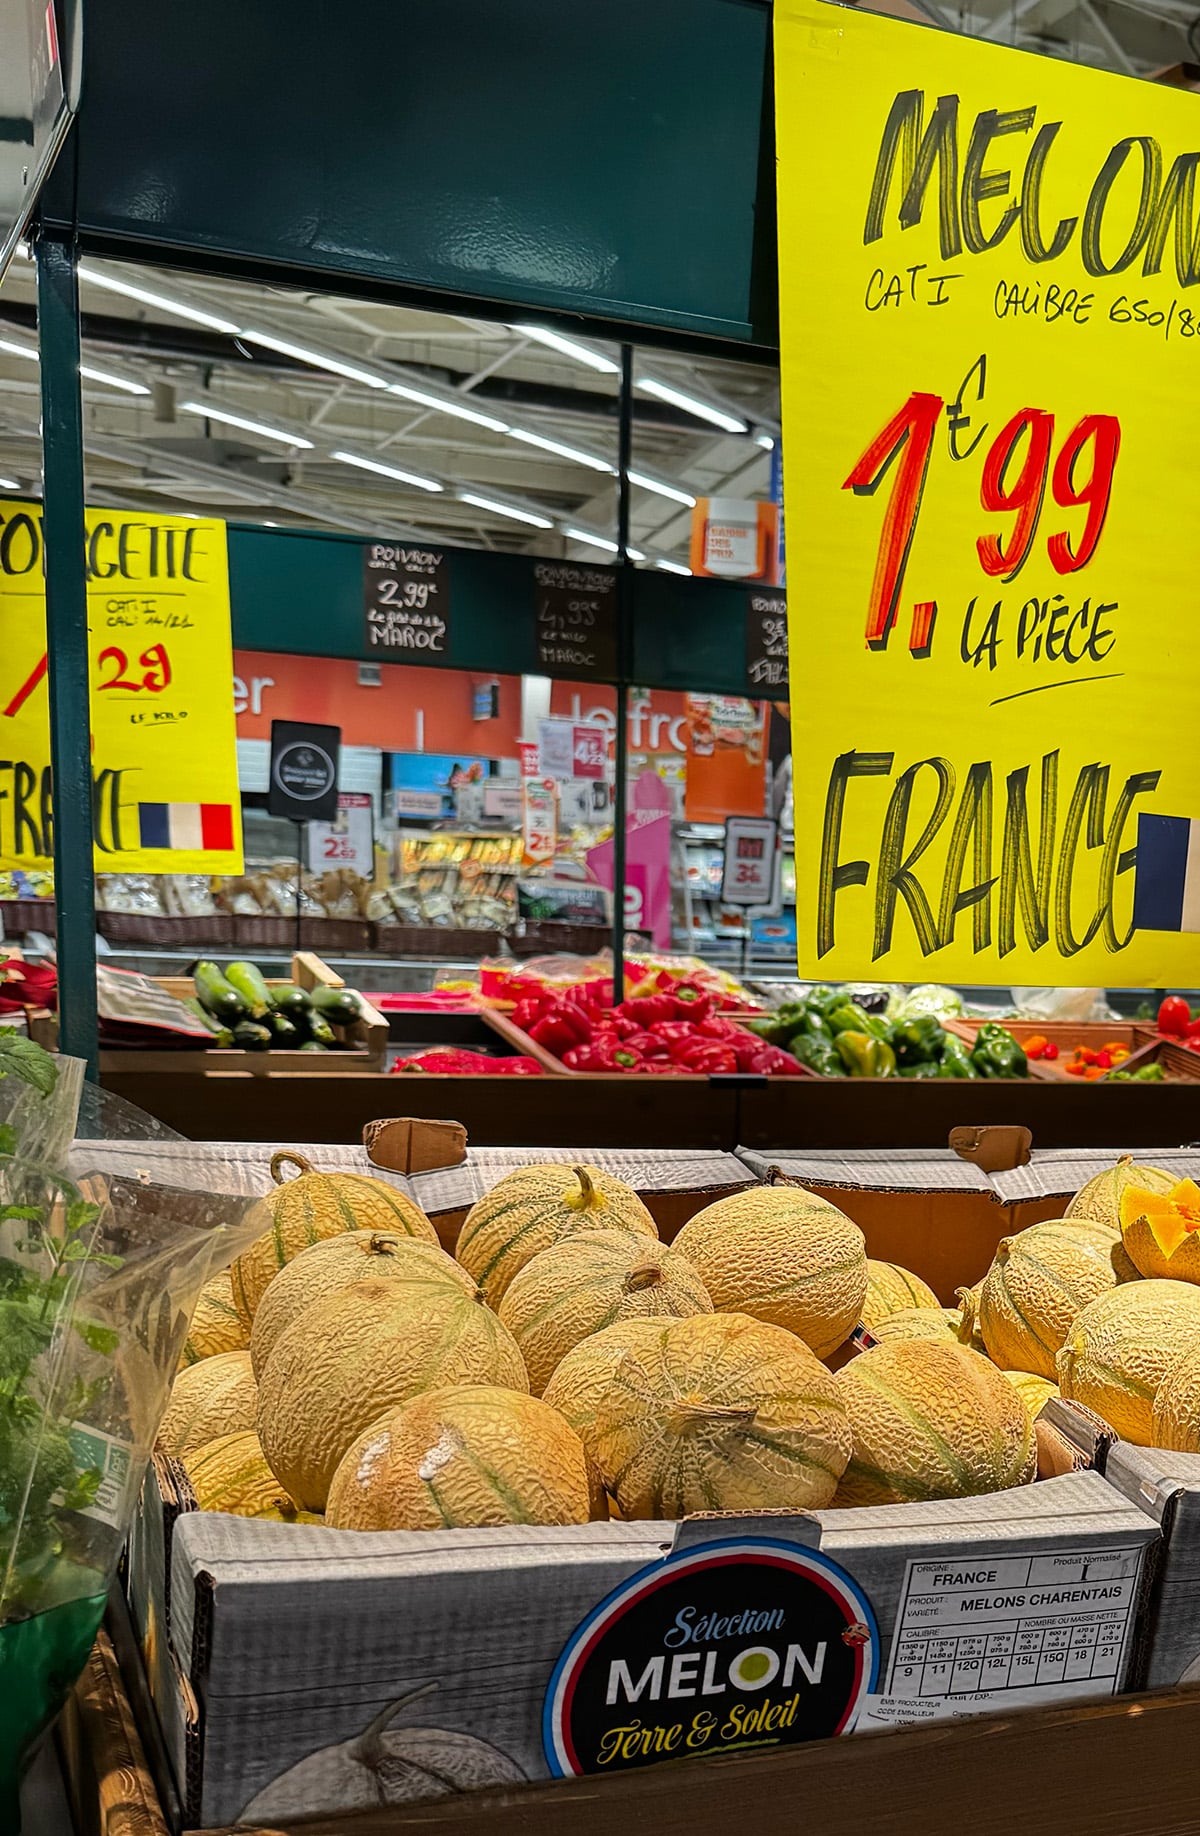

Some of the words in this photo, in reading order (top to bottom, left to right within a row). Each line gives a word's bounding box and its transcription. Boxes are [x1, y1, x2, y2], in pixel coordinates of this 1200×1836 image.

[864, 263, 928, 313] CAT
[928, 273, 965, 306] I
[370, 624, 444, 651] MAROC
[959, 596, 1002, 671] LA
[817, 748, 1162, 963] FRANCE
[932, 1570, 998, 1587] FRANCE
[960, 1595, 1026, 1612] MELONS
[1029, 1586, 1123, 1606] CHARENTAIS
[663, 1606, 786, 1649] Sélection
[604, 1641, 828, 1706] MELON
[903, 1666, 913, 1678] 9
[931, 1663, 947, 1675] 11
[956, 1659, 980, 1672] 12Q
[987, 1657, 1008, 1669] 12L
[1015, 1655, 1036, 1666] 15L
[1043, 1651, 1065, 1664] 15Q
[1074, 1649, 1088, 1660] 18
[1100, 1646, 1115, 1657] 21
[596, 1718, 684, 1765] Terre
[686, 1710, 719, 1748] &
[719, 1692, 801, 1740] Soleil
